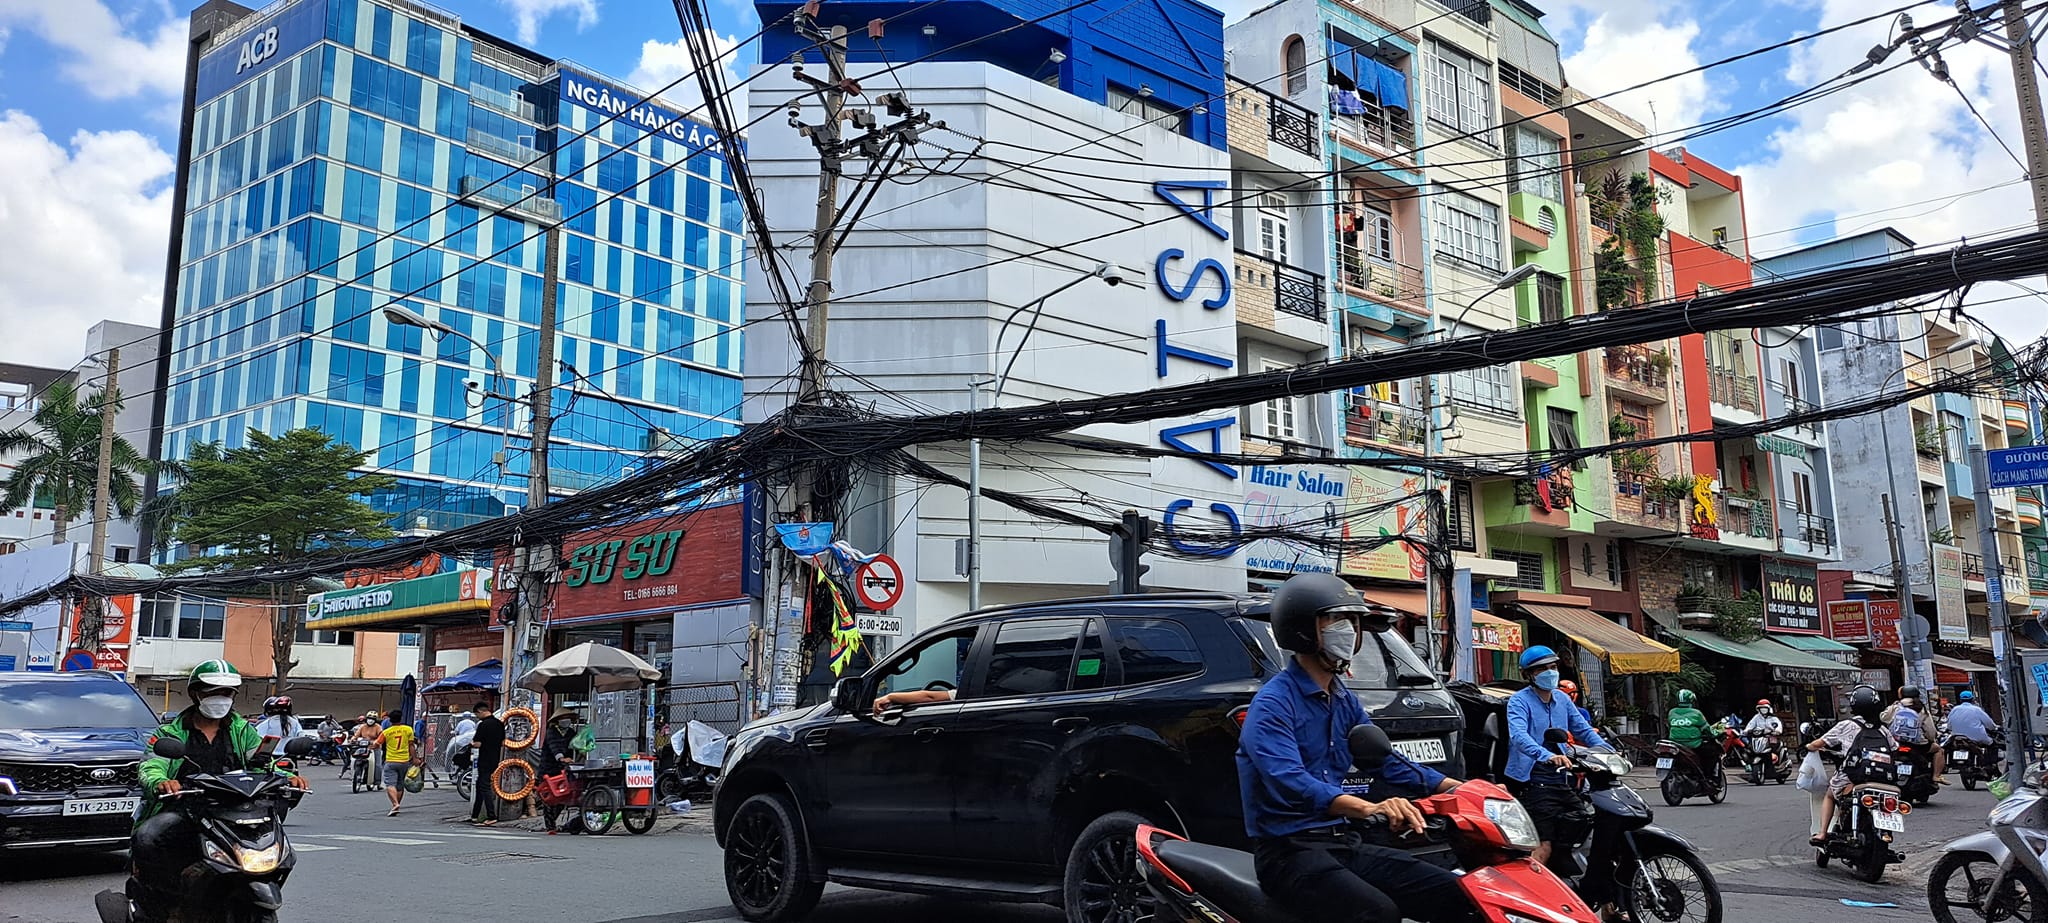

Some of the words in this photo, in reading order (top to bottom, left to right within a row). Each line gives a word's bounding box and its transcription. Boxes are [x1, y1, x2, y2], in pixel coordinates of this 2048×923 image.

[236, 26, 279, 74] ACB
[567, 79, 627, 117] NGÂN
[629, 104, 685, 140] HÀNG
[687, 124, 701, 147] Á
[2005, 450, 2048, 464] ĐƯỜNG
[1249, 463, 1293, 489] Hair
[1296, 469, 1344, 497] Salon
[1992, 469, 2010, 484] CÁCH
[566, 539, 623, 588] SU
[622, 529, 685, 580] SU
[1769, 578, 1797, 602] THÁI
[1799, 584, 1814, 604] 68
[1870, 605, 1894, 615] Phở
[1670, 718, 1693, 726] Grab
[395, 735, 403, 751] 7
